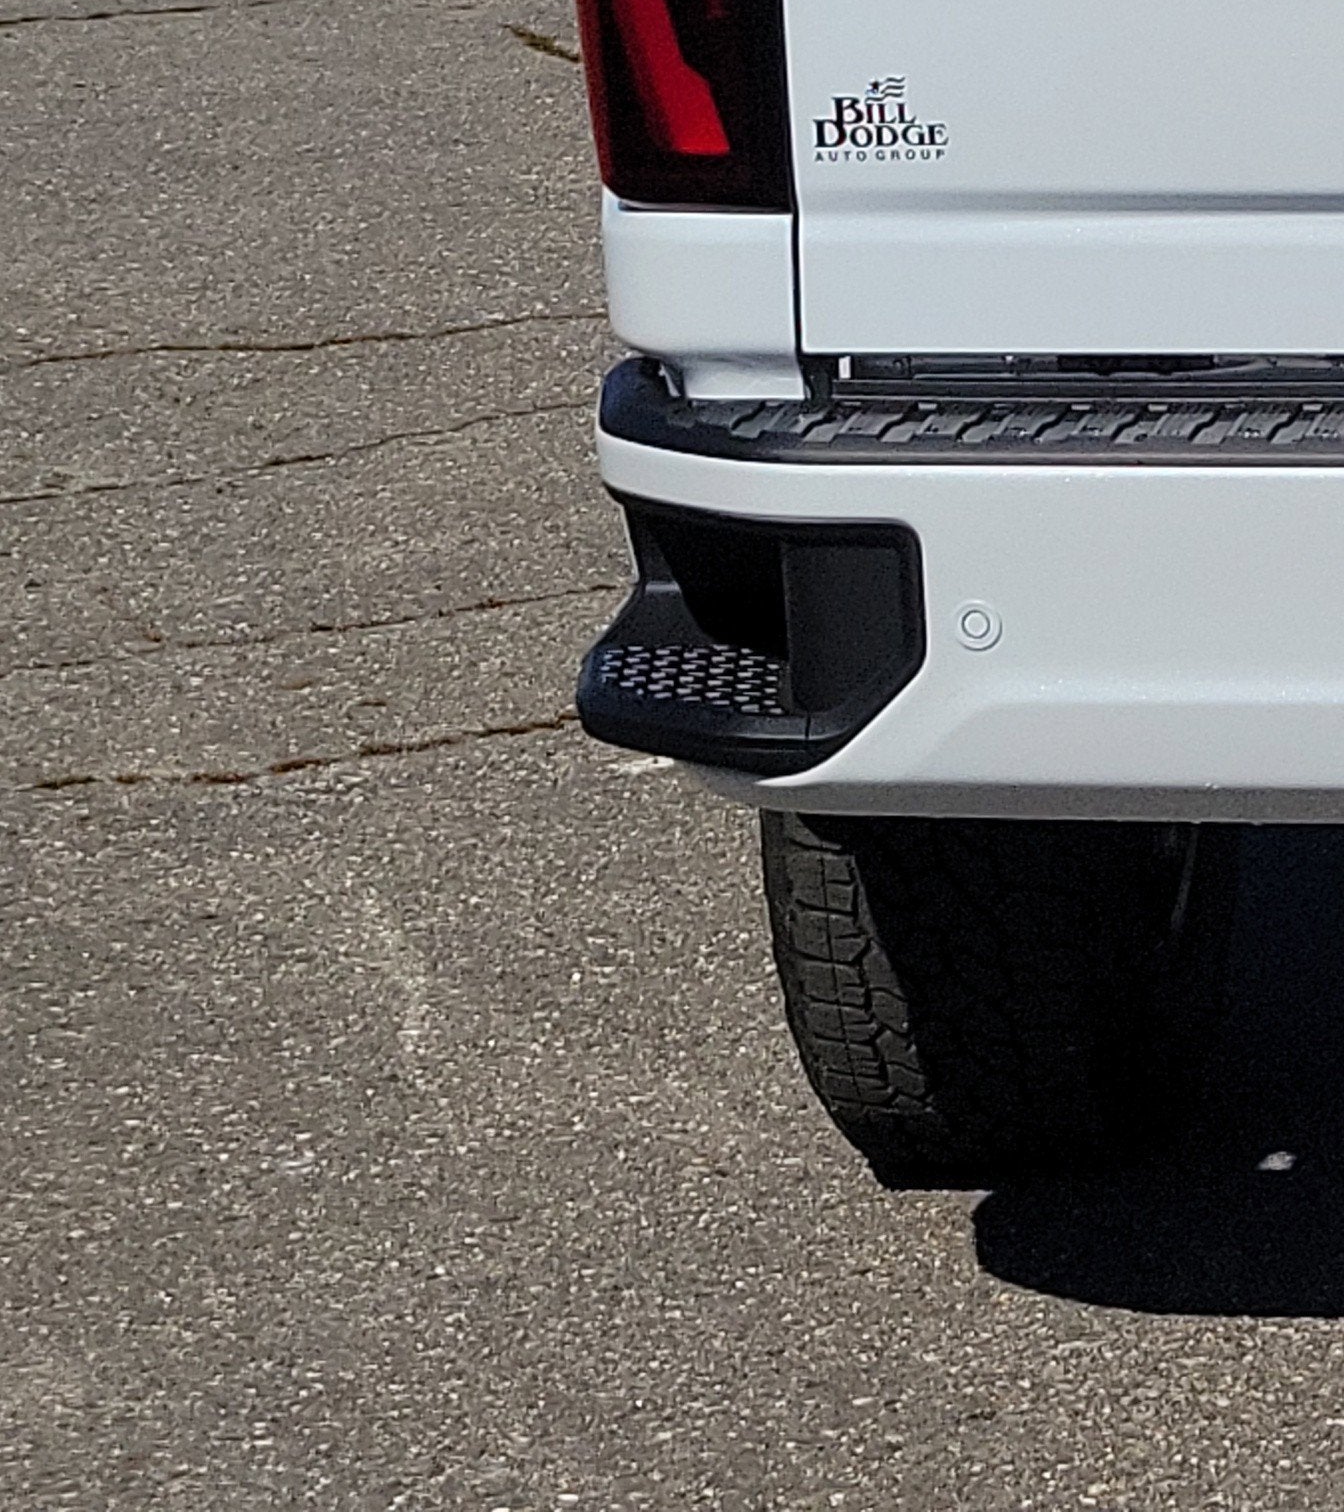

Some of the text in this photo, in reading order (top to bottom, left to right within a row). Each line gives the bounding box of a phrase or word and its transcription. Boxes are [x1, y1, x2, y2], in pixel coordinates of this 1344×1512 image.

[832, 96, 916, 124] BILL
[813, 119, 949, 148] DODGE
[814, 148, 946, 162] AUTO GROUP
